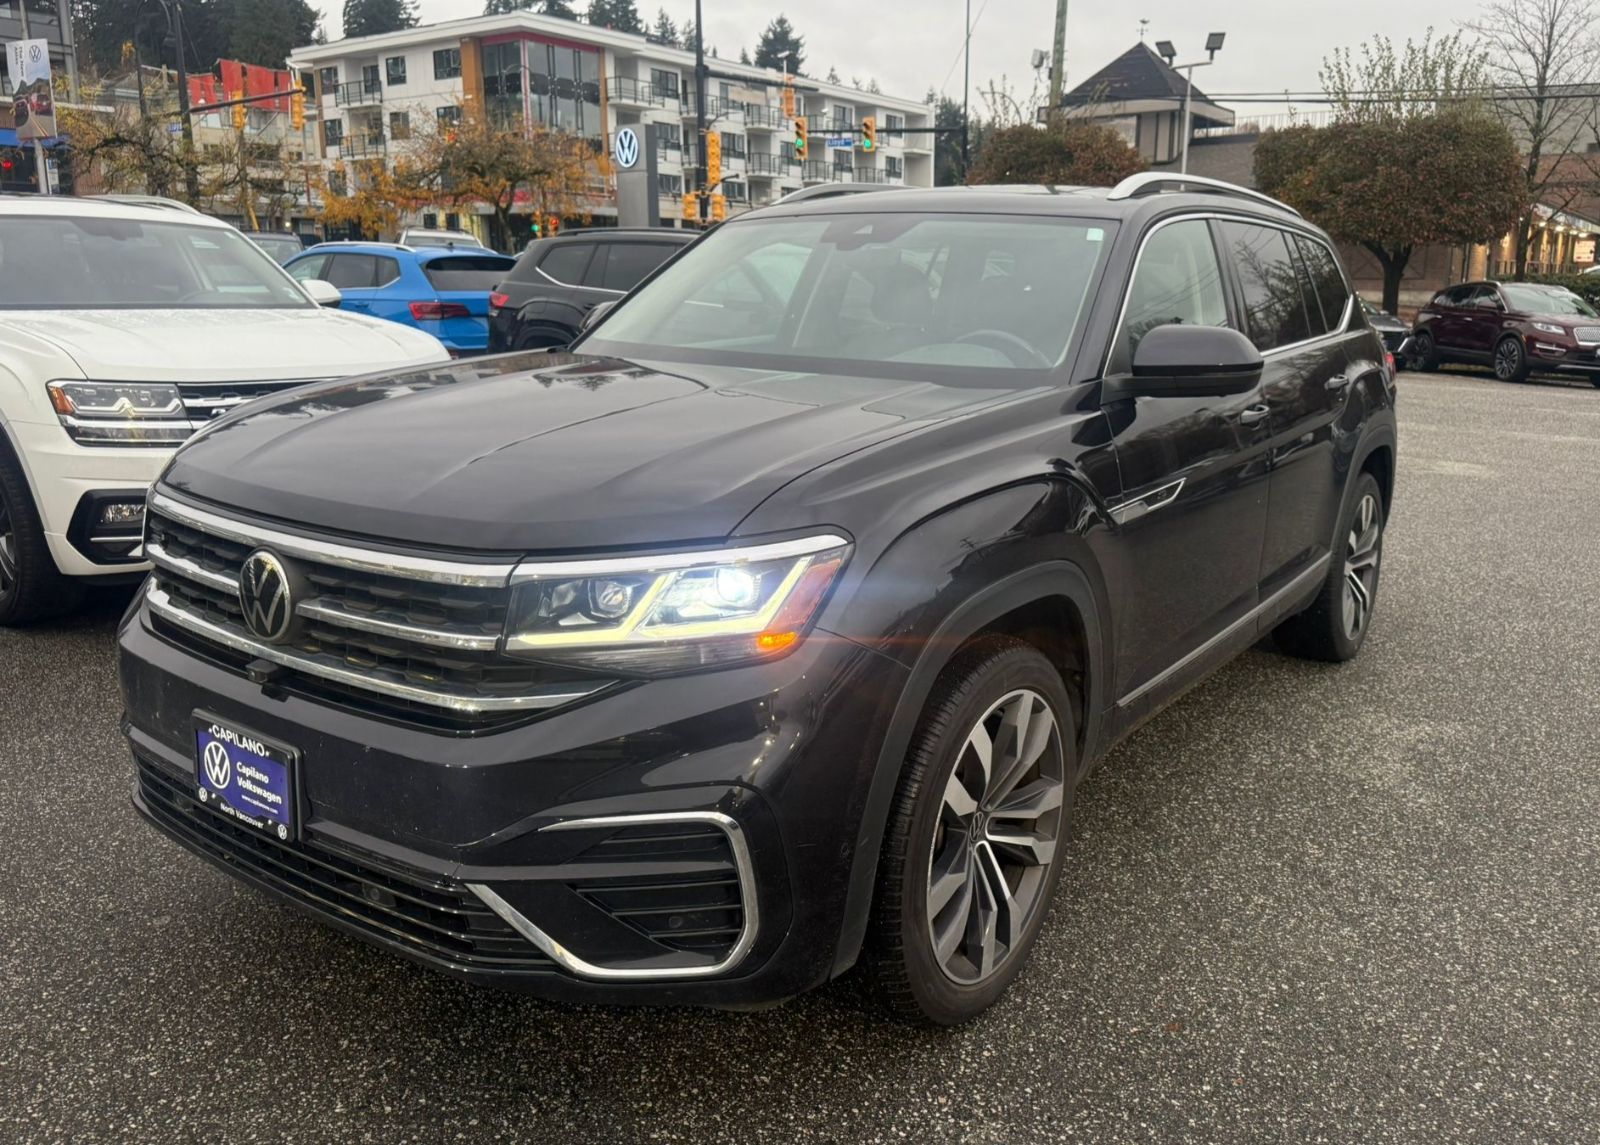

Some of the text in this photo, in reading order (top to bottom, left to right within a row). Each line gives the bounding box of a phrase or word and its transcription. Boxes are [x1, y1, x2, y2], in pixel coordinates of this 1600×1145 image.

[29, 45, 42, 63] VW
[616, 128, 638, 168] VW
[239, 551, 291, 640] VW
[212, 724, 265, 757] CAPILANO
[204, 741, 231, 789] VW
[236, 762, 270, 784] Capilano
[236, 777, 282, 805] Volkswagen
[220, 803, 236, 816] North
[235, 810, 265, 829] Vancouver
